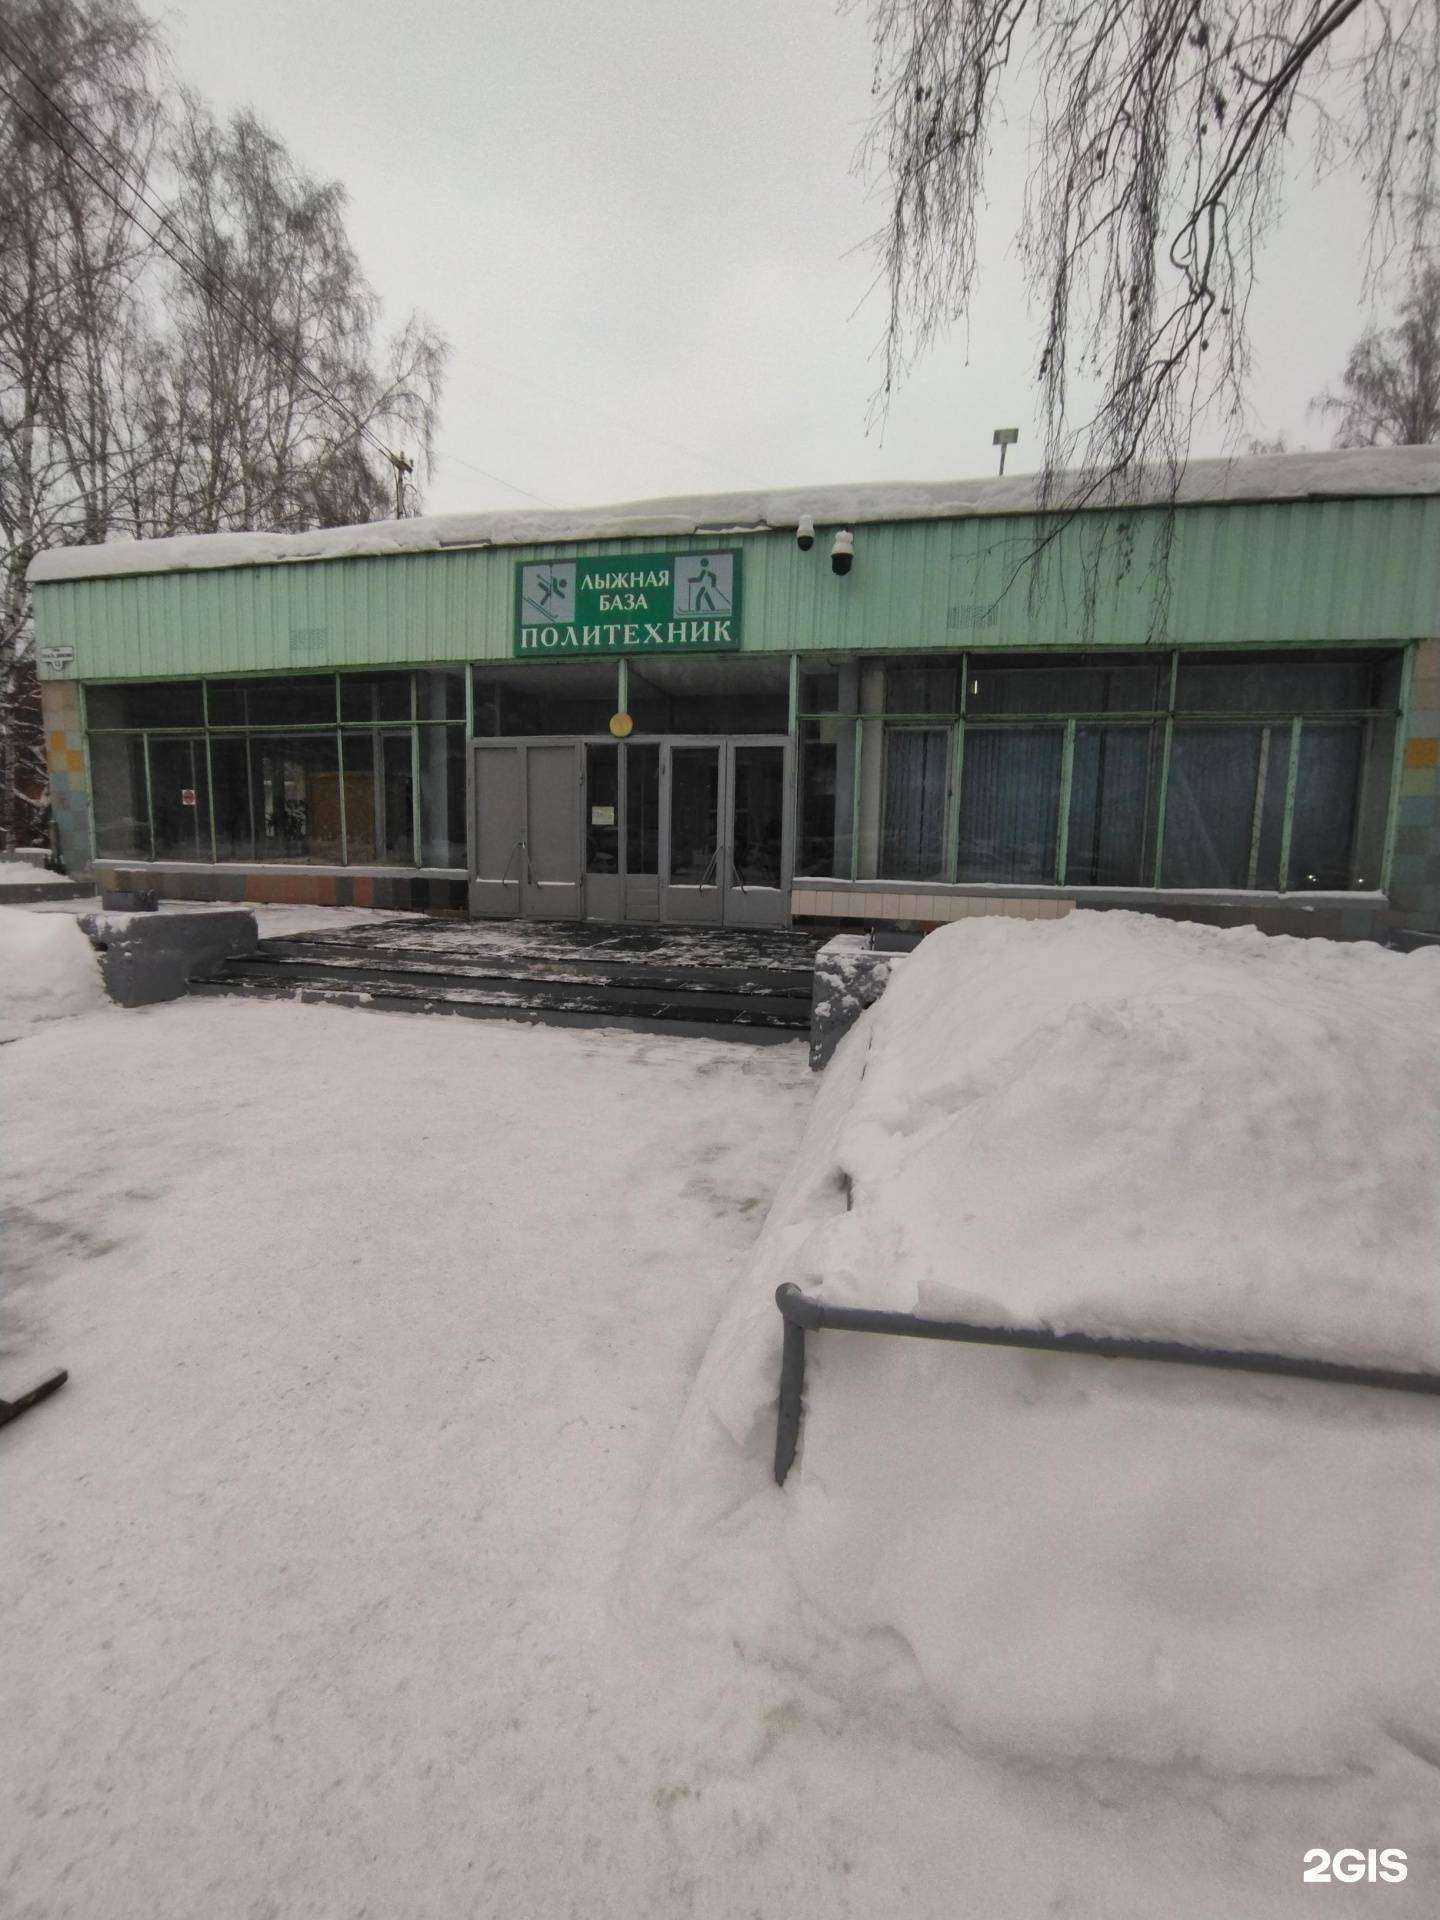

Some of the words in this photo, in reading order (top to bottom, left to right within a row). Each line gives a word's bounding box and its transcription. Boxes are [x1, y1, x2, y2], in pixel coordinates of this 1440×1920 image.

[581, 570, 670, 590] ЛЫЖНАЯ
[599, 594, 648, 611] БАЗА
[520, 621, 732, 648] ПОЛИТЕХНИК
